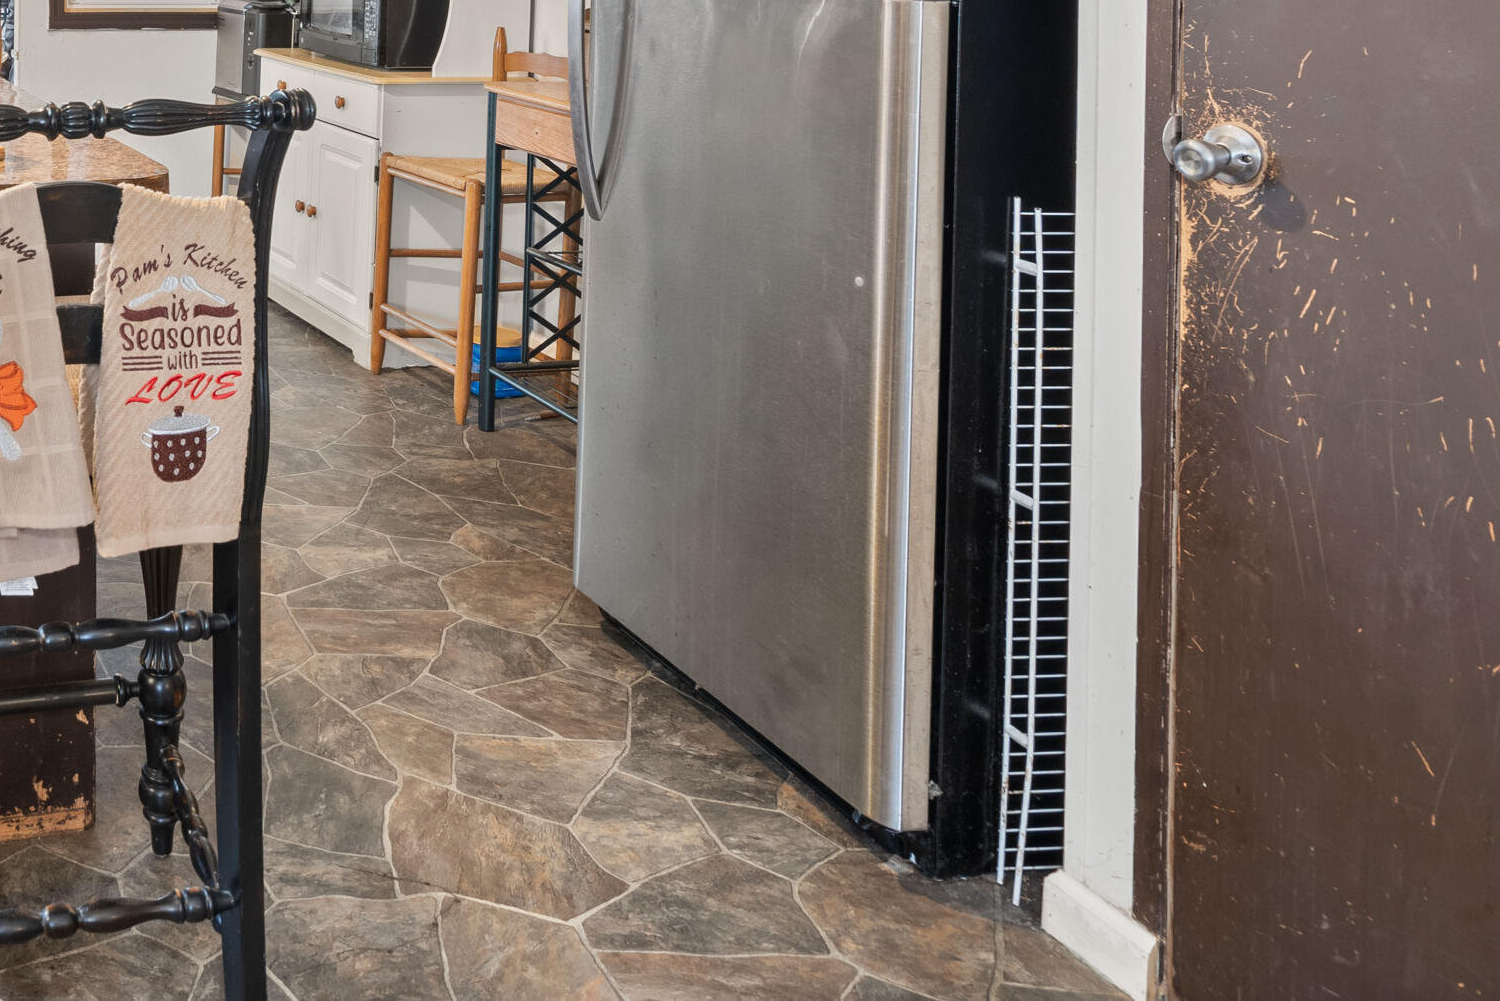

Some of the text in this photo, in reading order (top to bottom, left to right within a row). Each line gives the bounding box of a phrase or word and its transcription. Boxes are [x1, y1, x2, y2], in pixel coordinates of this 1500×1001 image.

[111, 242, 249, 295] Pam's Kitchen
[171, 293, 190, 322] is
[119, 318, 242, 351] Seasoned
[167, 350, 198, 370] with
[124, 370, 242, 406] LOVE
